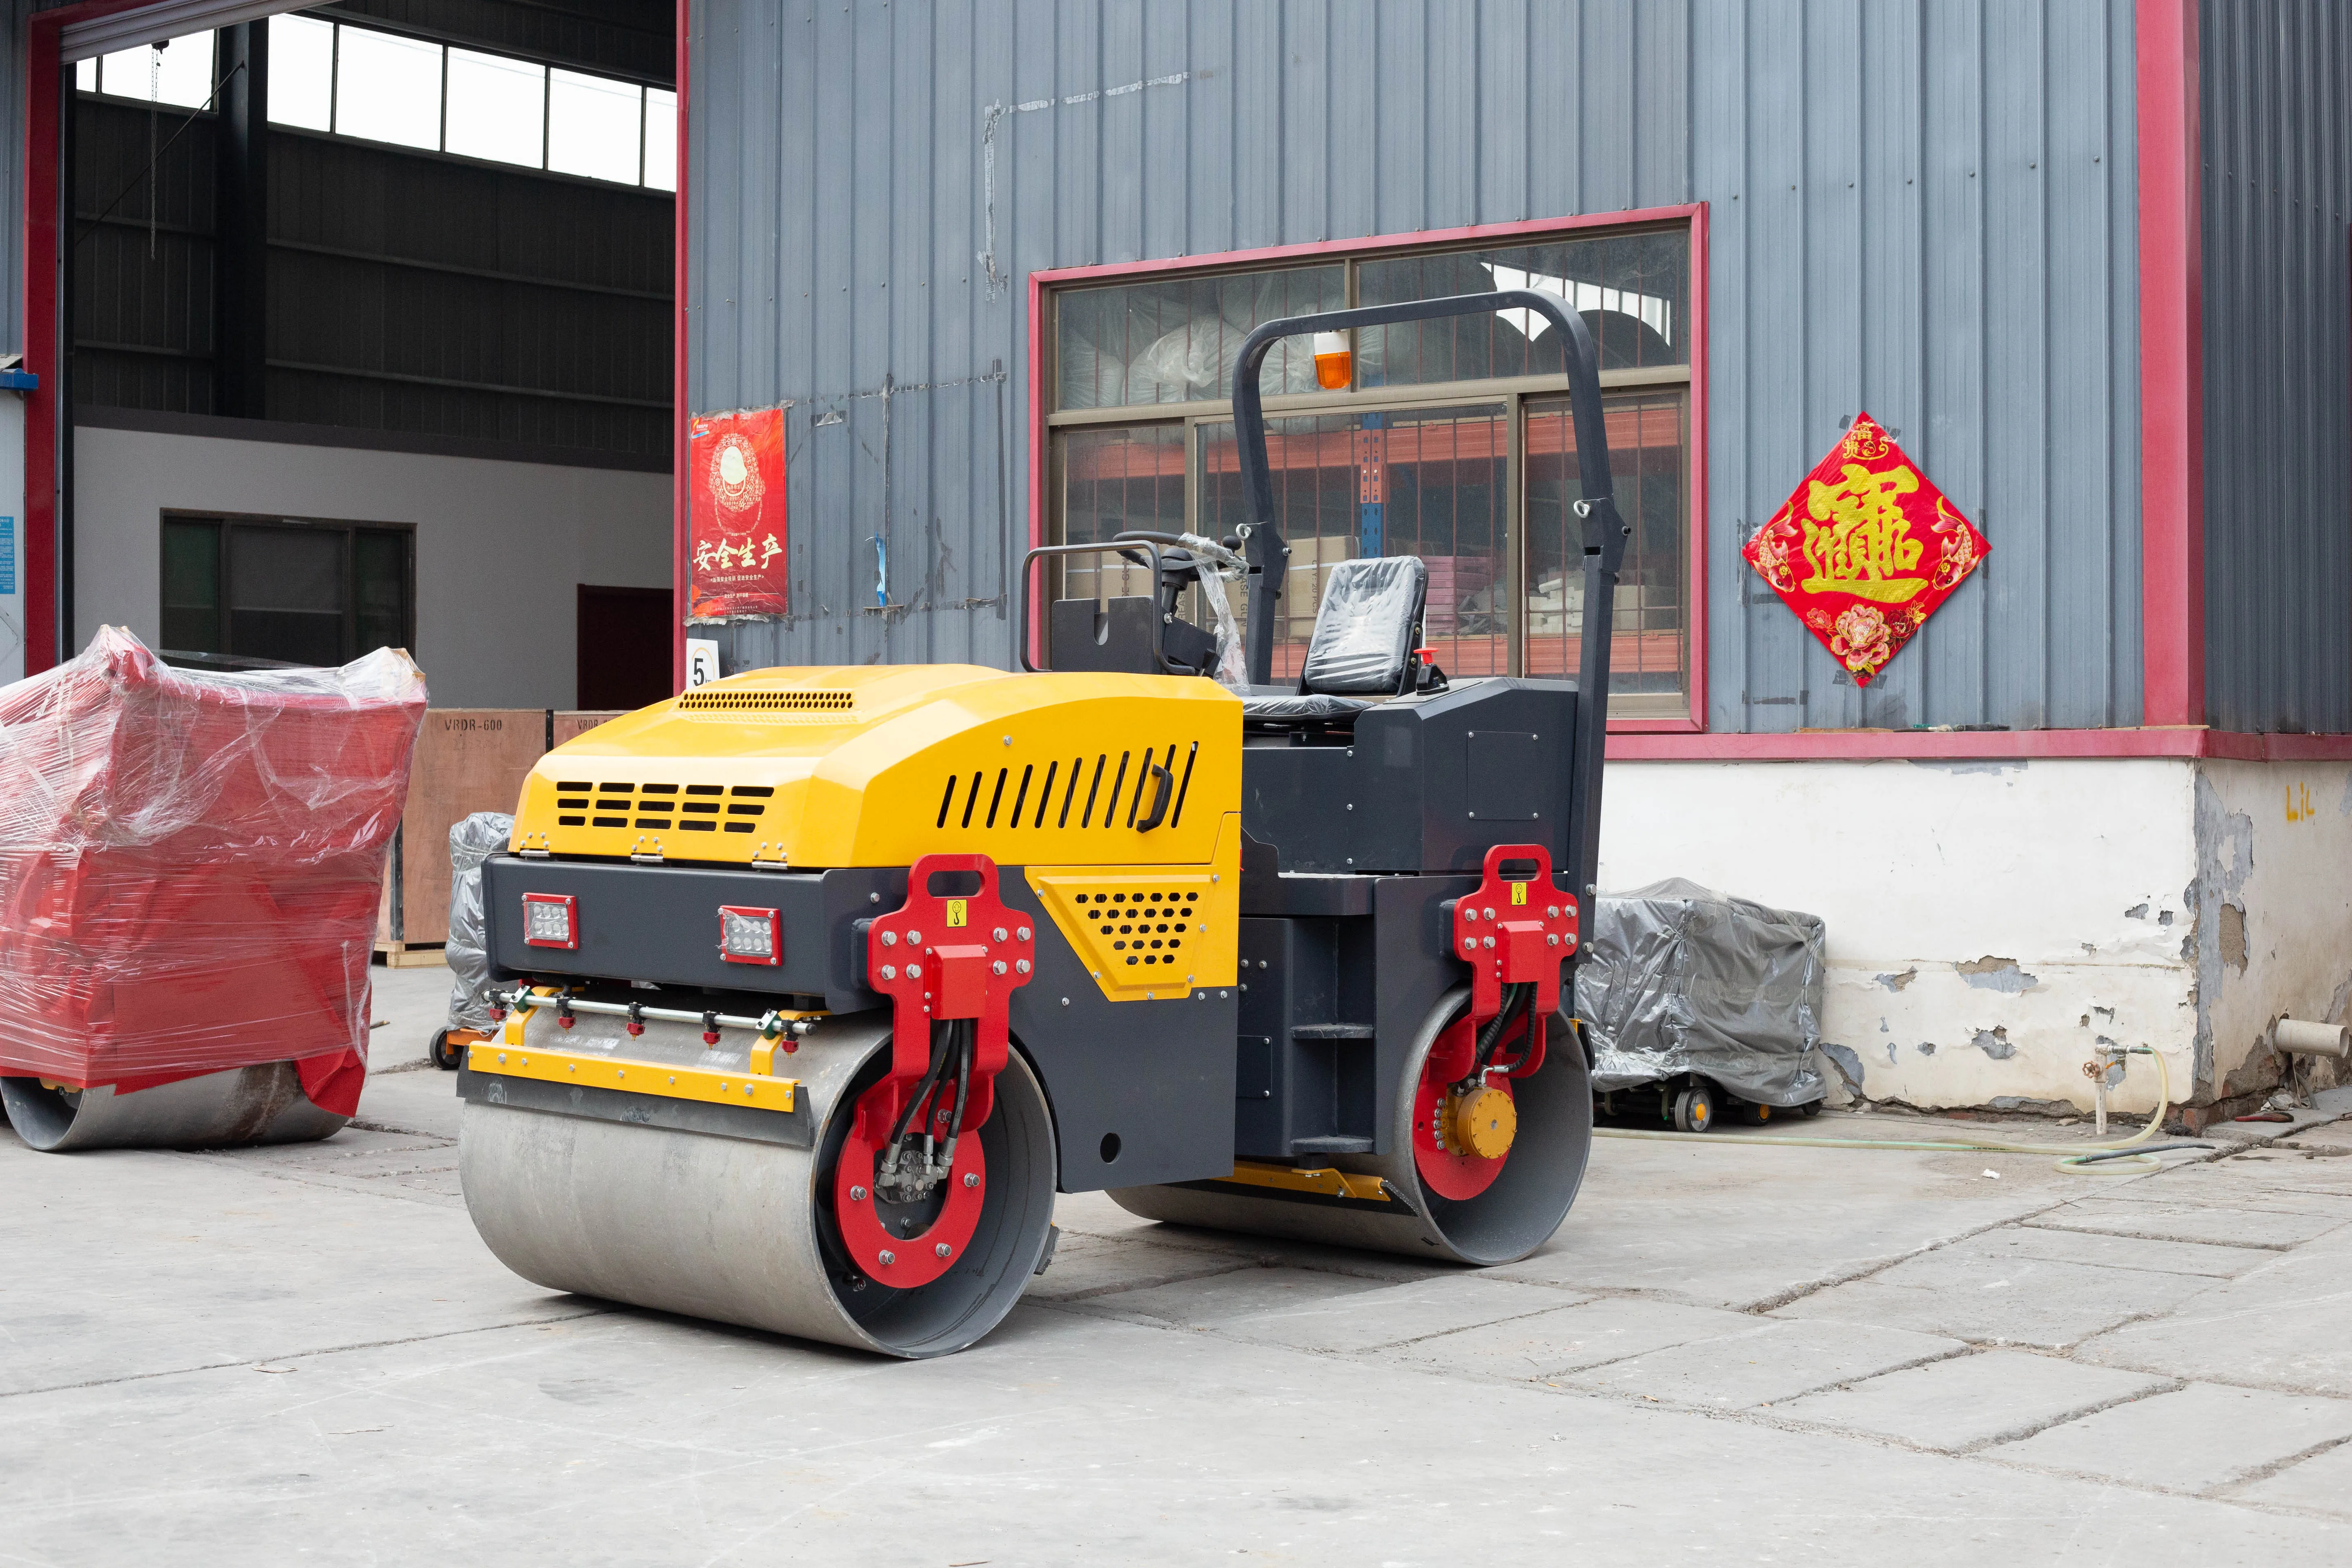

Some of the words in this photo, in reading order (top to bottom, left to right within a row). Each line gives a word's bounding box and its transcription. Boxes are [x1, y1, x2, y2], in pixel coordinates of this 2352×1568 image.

[721, 437, 742, 447] 安全第一
[693, 533, 782, 571] 安全生产
[693, 658, 704, 686] 5
[445, 719, 502, 731] VRDR-600
